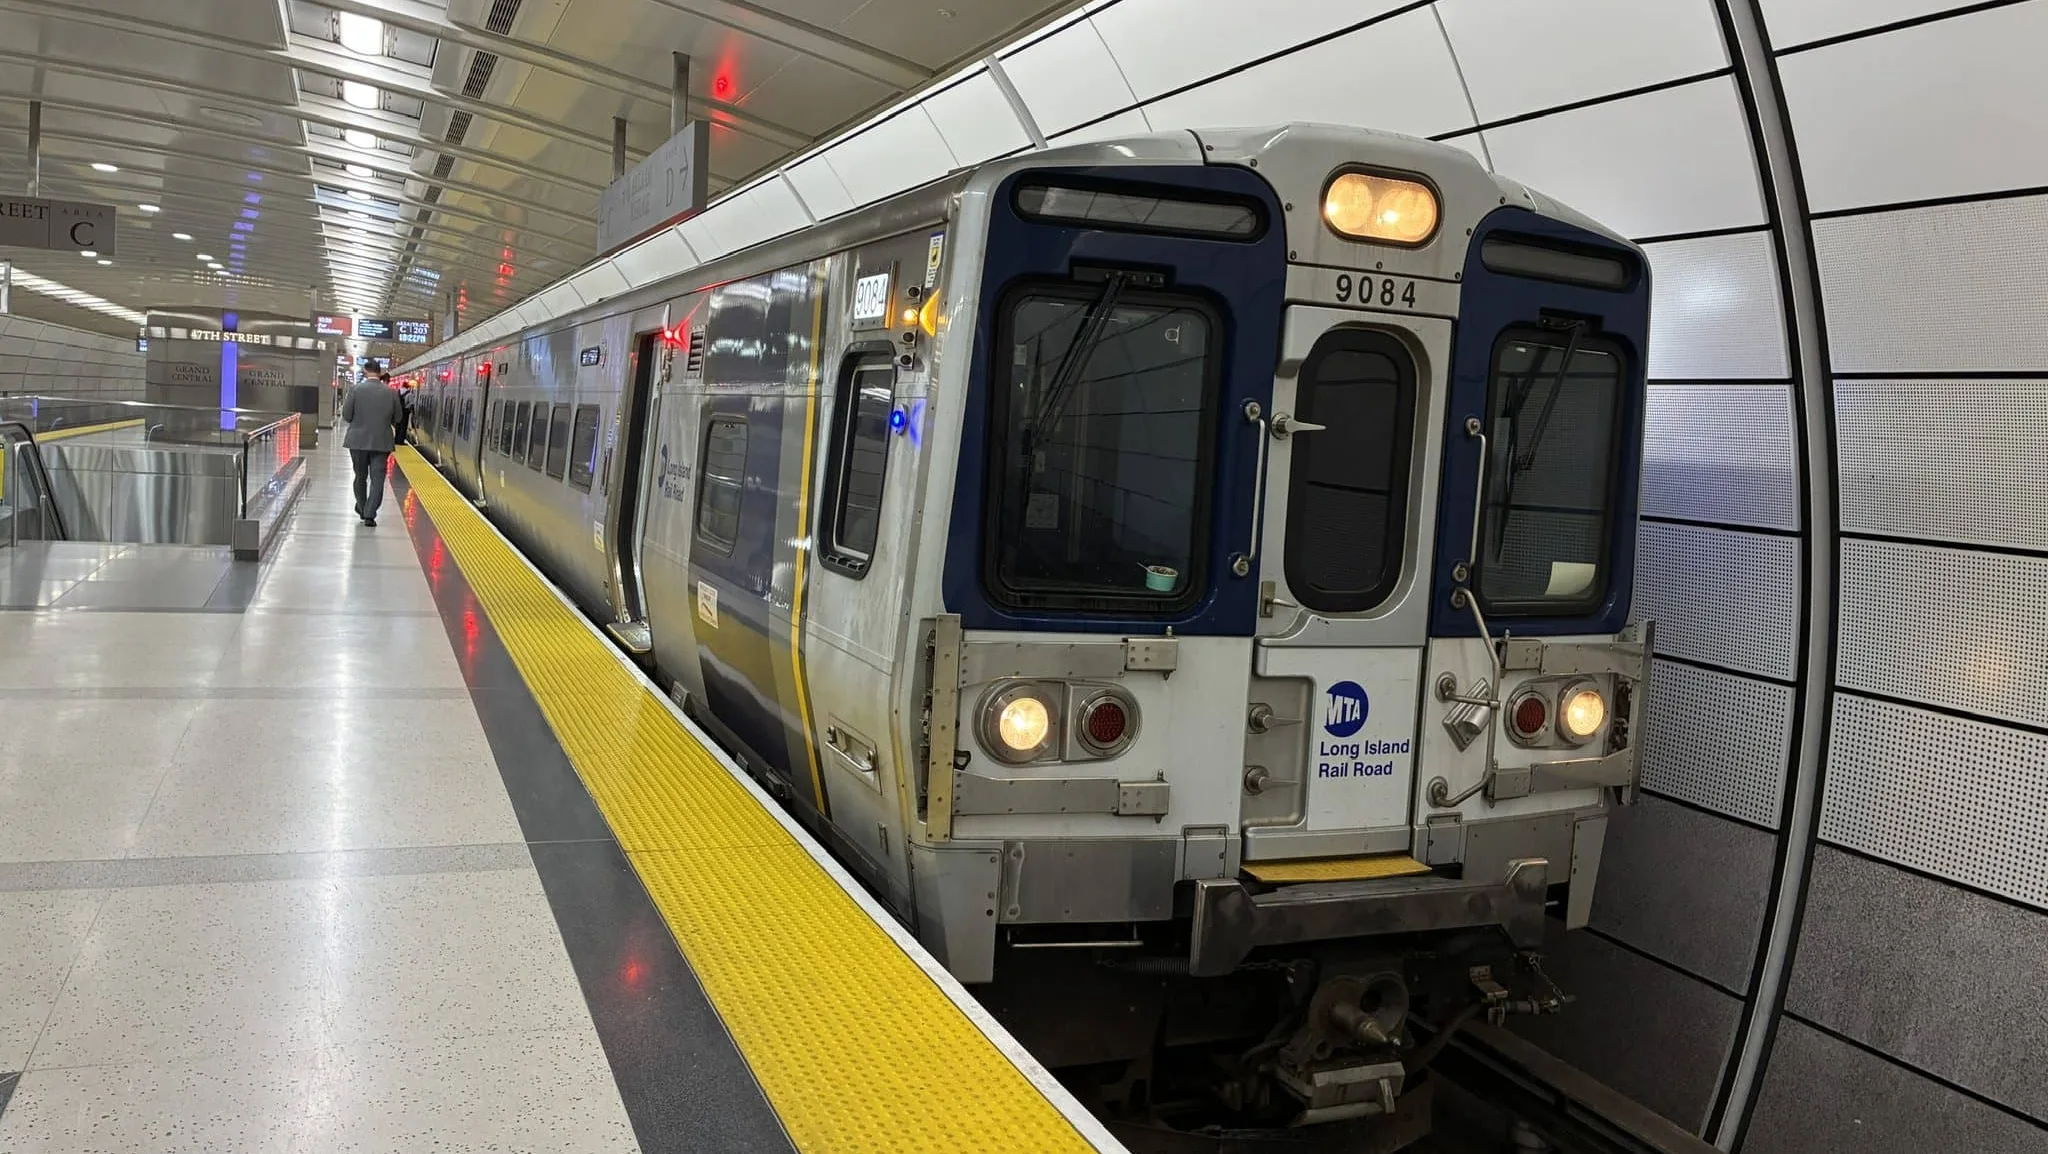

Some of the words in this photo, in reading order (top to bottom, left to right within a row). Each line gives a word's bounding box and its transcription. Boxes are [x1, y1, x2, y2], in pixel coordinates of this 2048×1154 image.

[61, 208, 103, 218] AREA
[70, 221, 94, 247] C
[856, 279, 887, 316] 9084
[1336, 274, 1415, 308] 9084
[191, 329, 221, 341] 47TH
[223, 331, 268, 344] STREET
[172, 374, 213, 383] CENTRAL
[175, 366, 210, 375] GRAND
[249, 370, 284, 379] GRAND
[244, 378, 288, 388] CENTRAL
[1325, 693, 1361, 727] MTA
[1320, 741, 1360, 761] Long
[1364, 738, 1410, 755] Island
[1319, 762, 1349, 778] Rail
[1353, 761, 1393, 777] Road
